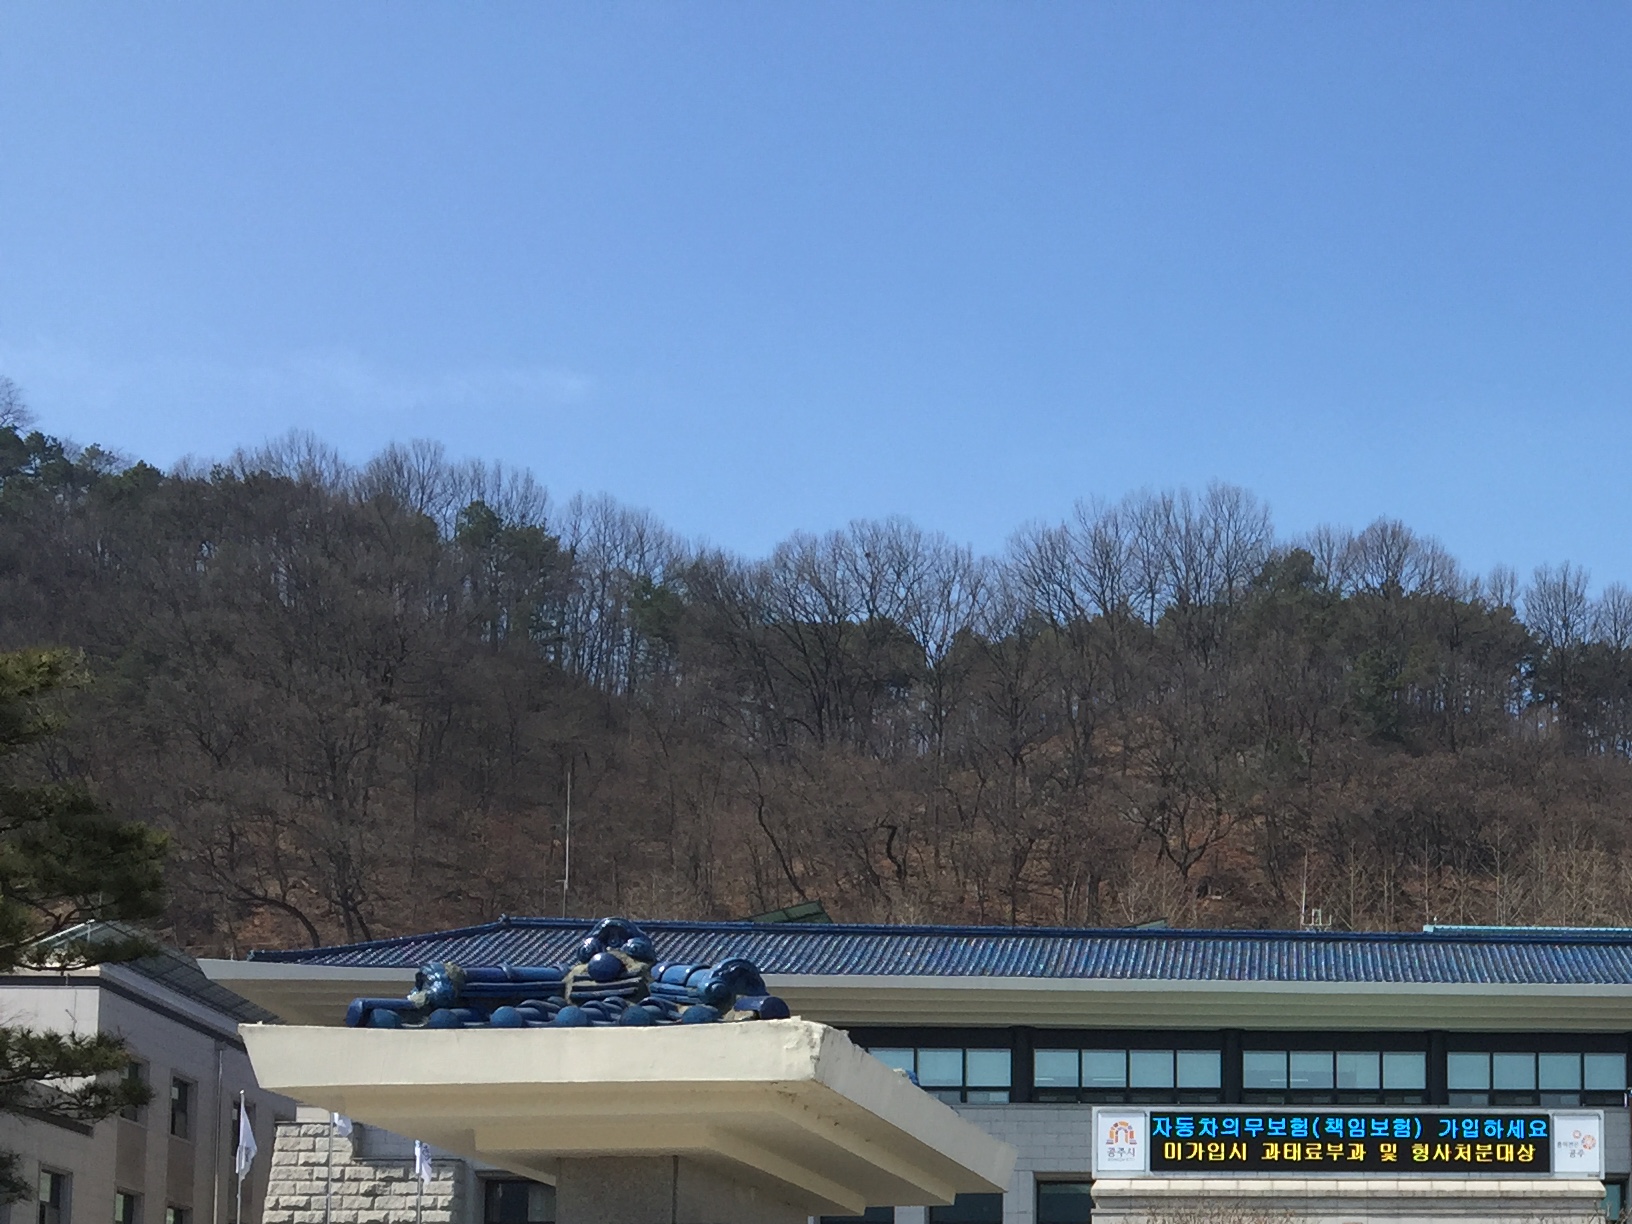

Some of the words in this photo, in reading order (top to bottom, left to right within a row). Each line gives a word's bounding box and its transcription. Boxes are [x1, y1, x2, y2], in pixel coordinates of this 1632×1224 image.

[1152, 1117, 1422, 1138] 자동차의무보험(책임보험)
[1438, 1118, 1548, 1139] 가입하세요
[1107, 1147, 1136, 1158] 공주시
[1164, 1142, 1248, 1161] 미가입시
[1261, 1142, 1367, 1162] 과태료부과
[1380, 1143, 1398, 1162] 및
[1411, 1143, 1536, 1162] 형사처분대상
